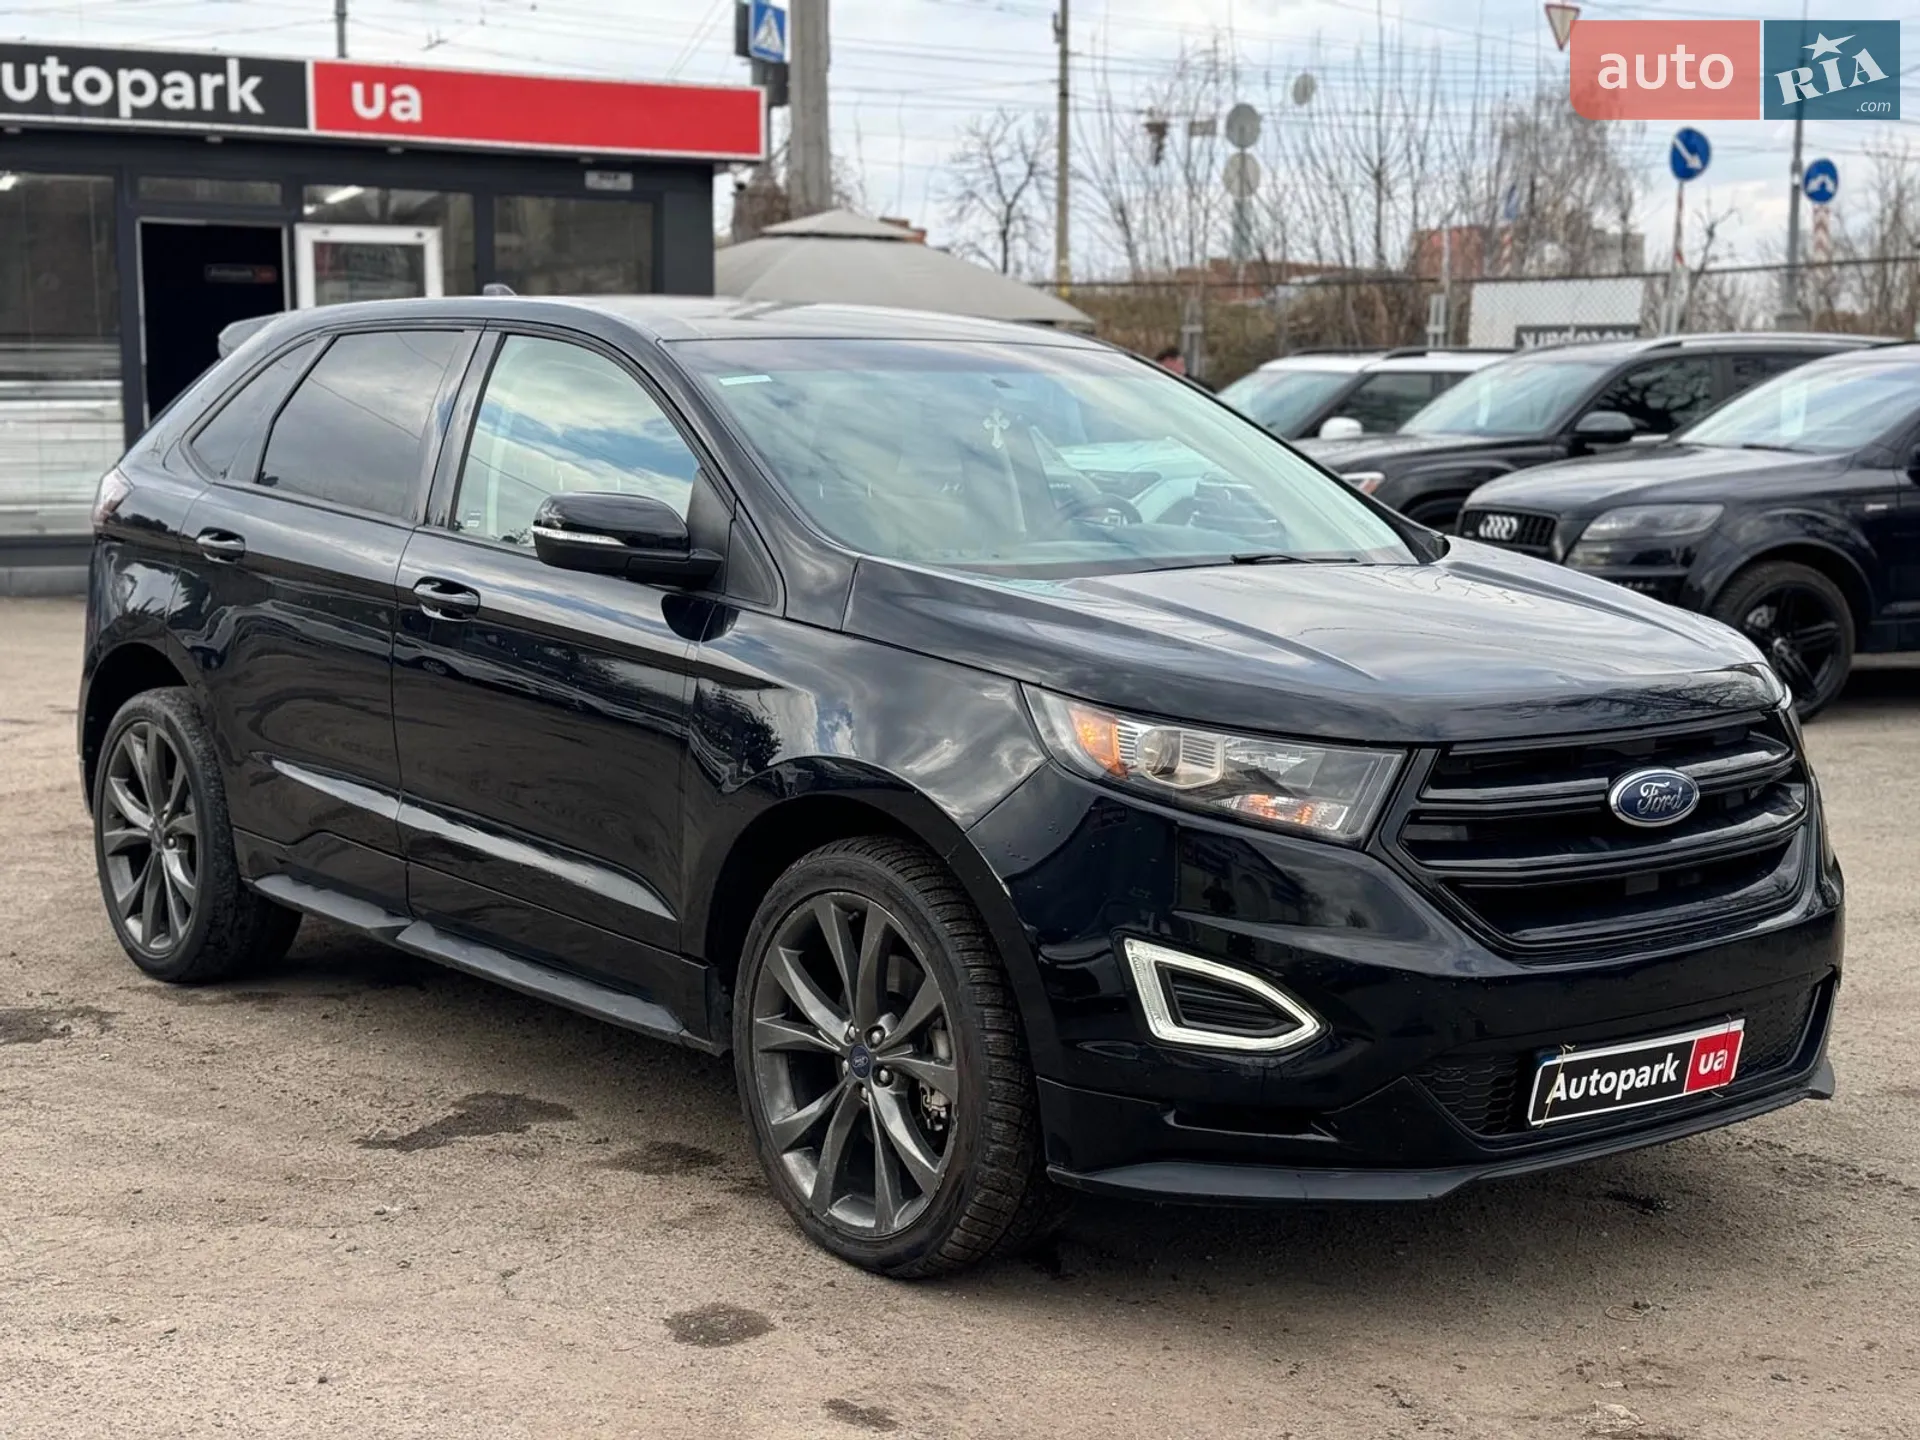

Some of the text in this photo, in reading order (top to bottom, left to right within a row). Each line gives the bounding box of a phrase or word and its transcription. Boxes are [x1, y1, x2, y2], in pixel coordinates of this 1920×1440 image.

[0, 55, 423, 123] utopark ua
[1636, 781, 1684, 815] Ford
[1545, 1048, 1728, 1104] Autopark ua
